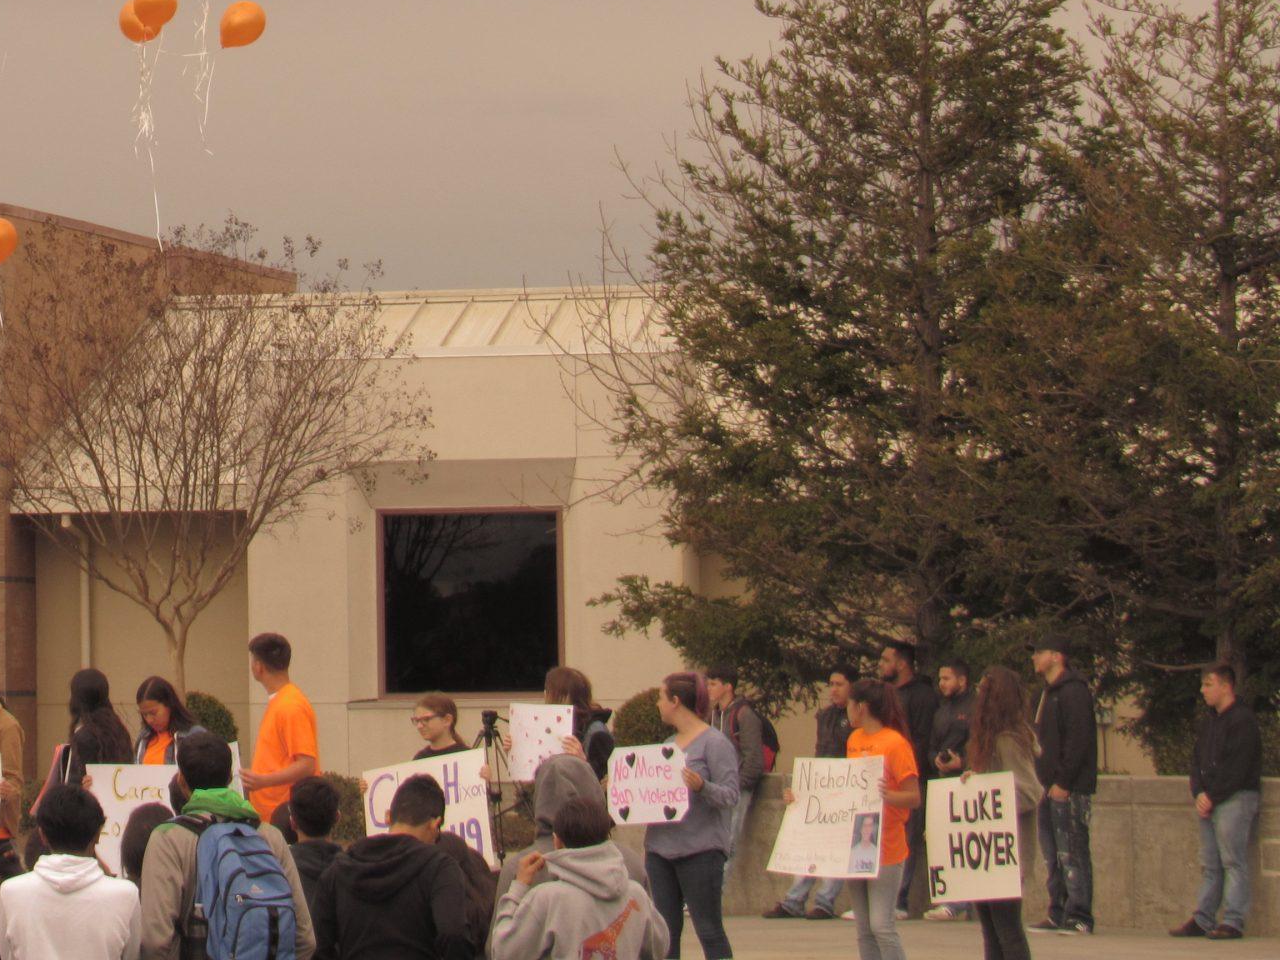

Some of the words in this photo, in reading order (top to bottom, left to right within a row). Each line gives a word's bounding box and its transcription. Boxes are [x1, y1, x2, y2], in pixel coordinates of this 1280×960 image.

[112, 767, 164, 803] Cara
[442, 760, 486, 806] Hixon
[613, 756, 629, 783] No
[634, 755, 673, 781] More
[798, 761, 871, 793] Nicholas
[804, 794, 858, 824] Dworet
[948, 830, 1018, 872] HOYER
